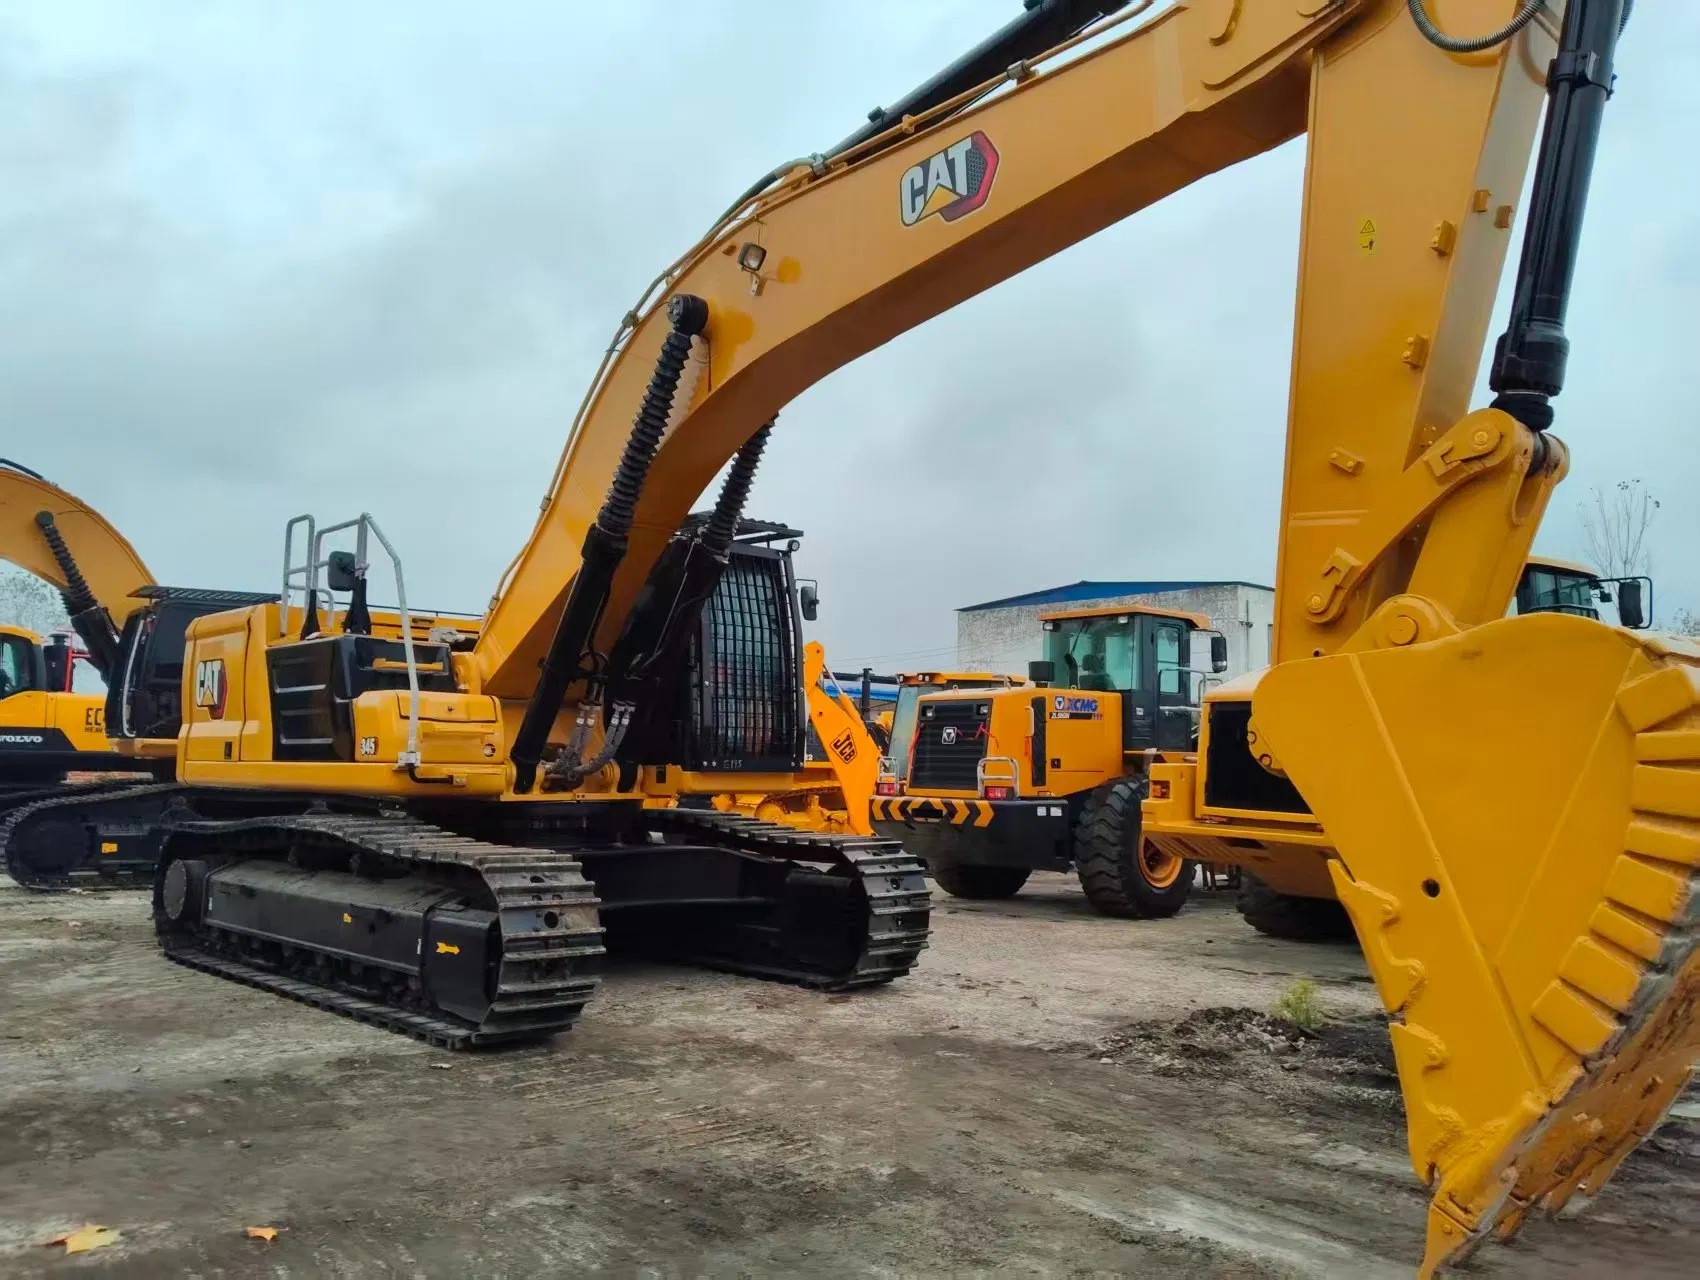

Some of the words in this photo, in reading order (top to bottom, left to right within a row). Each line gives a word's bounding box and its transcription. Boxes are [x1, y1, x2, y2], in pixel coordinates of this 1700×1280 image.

[901, 136, 972, 225] CAT
[196, 660, 223, 707] CAT
[1067, 698, 1098, 712] XCMG
[85, 707, 105, 726] EC
[0, 735, 43, 743] VOLVO
[360, 737, 376, 755] 345
[833, 733, 856, 761] JCB
